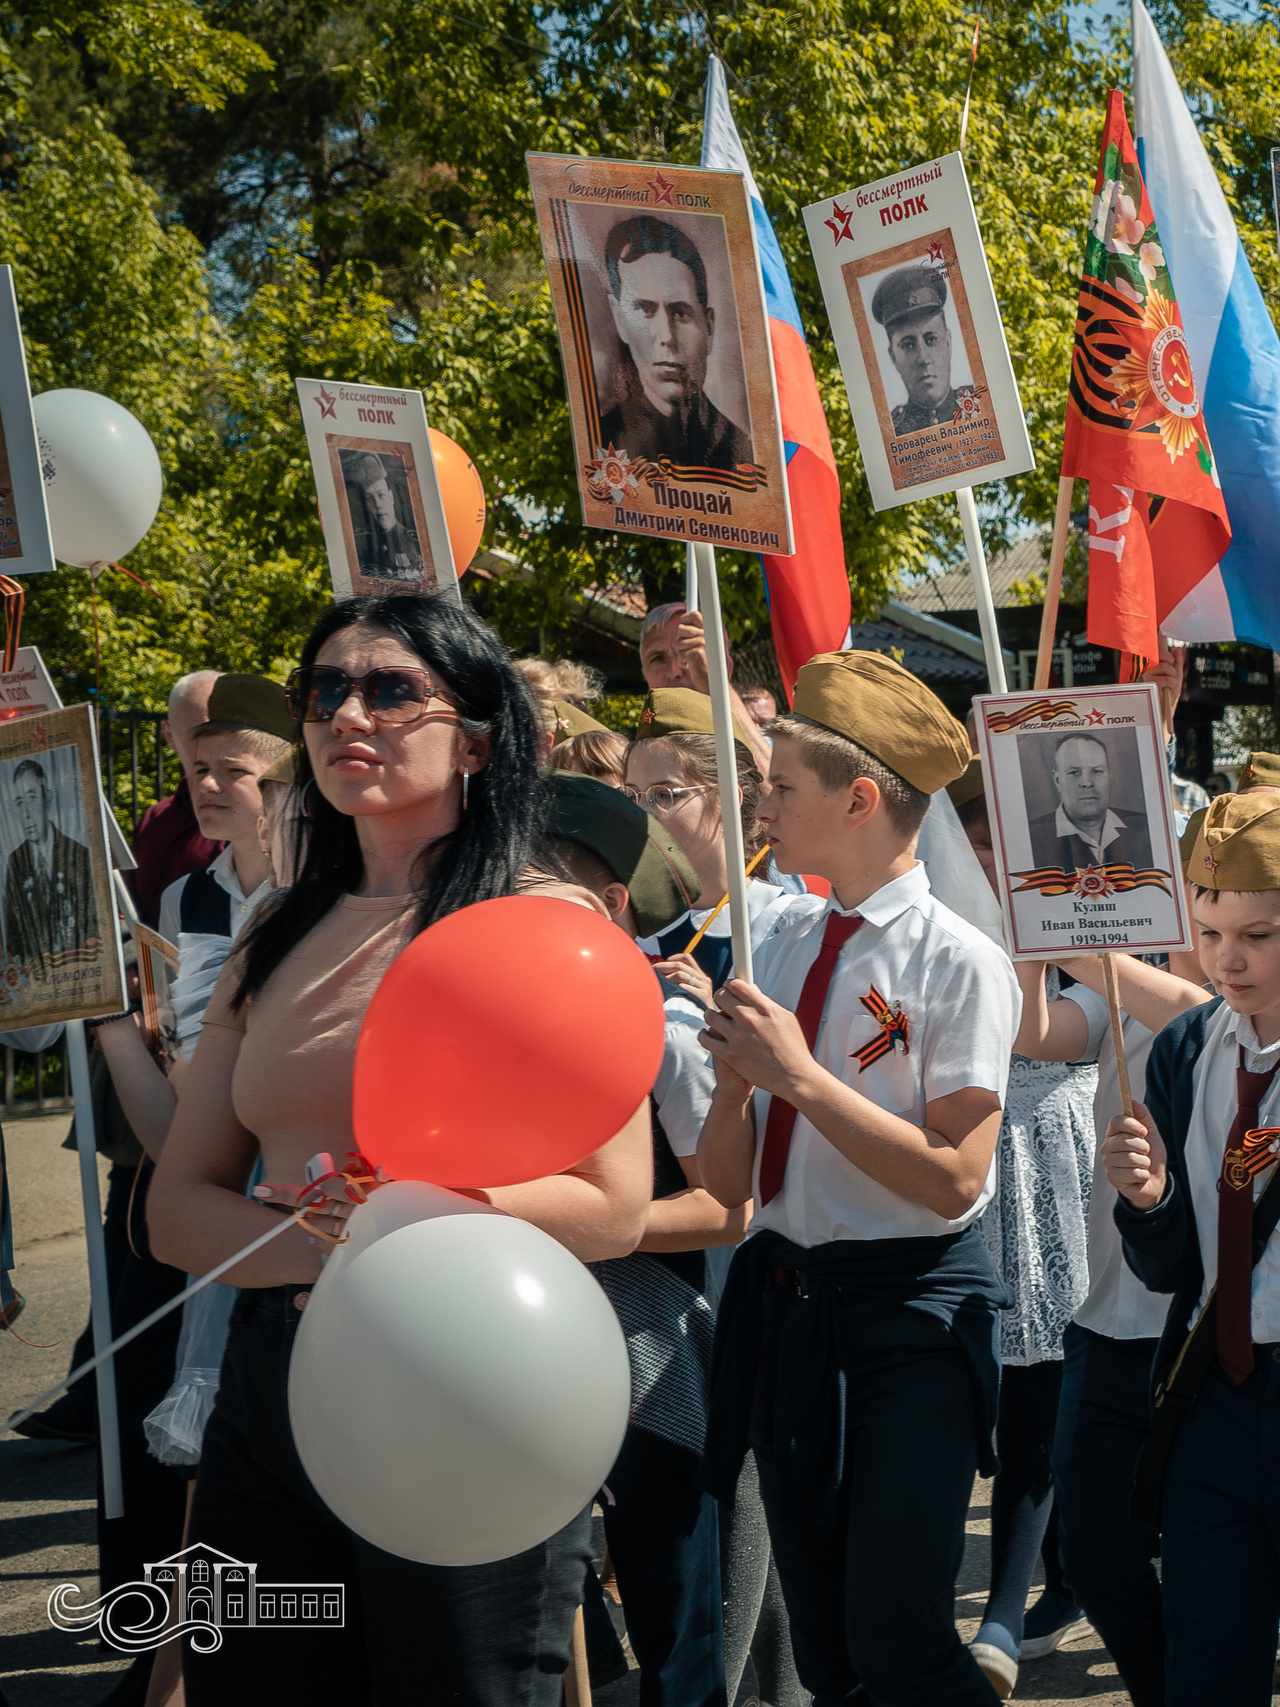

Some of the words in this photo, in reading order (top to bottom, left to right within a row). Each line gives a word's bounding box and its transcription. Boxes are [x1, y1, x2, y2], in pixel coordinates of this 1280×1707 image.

[855, 161, 943, 209] бессмертный
[878, 193, 930, 227] ПОЛК
[339, 387, 408, 408] бессмертный
[357, 408, 396, 425] ПОЛК
[890, 432, 939, 455] Броварец
[939, 417, 991, 440] Владимир
[891, 441, 954, 467] Тимофеевич
[919, 465, 957, 481] Советского
[979, 450, 1000, 465] (1943)
[938, 450, 967, 465] Красной
[967, 444, 991, 457] Армии
[652, 480, 733, 516] Процай
[614, 505, 686, 534] Дмитрий
[688, 516, 780, 549] Семенович
[1072, 901, 1117, 916] Кулиш
[1041, 919, 1076, 932] Иван
[1078, 917, 1153, 931] Васильевич
[1069, 932, 1130, 946] 1919-1994
